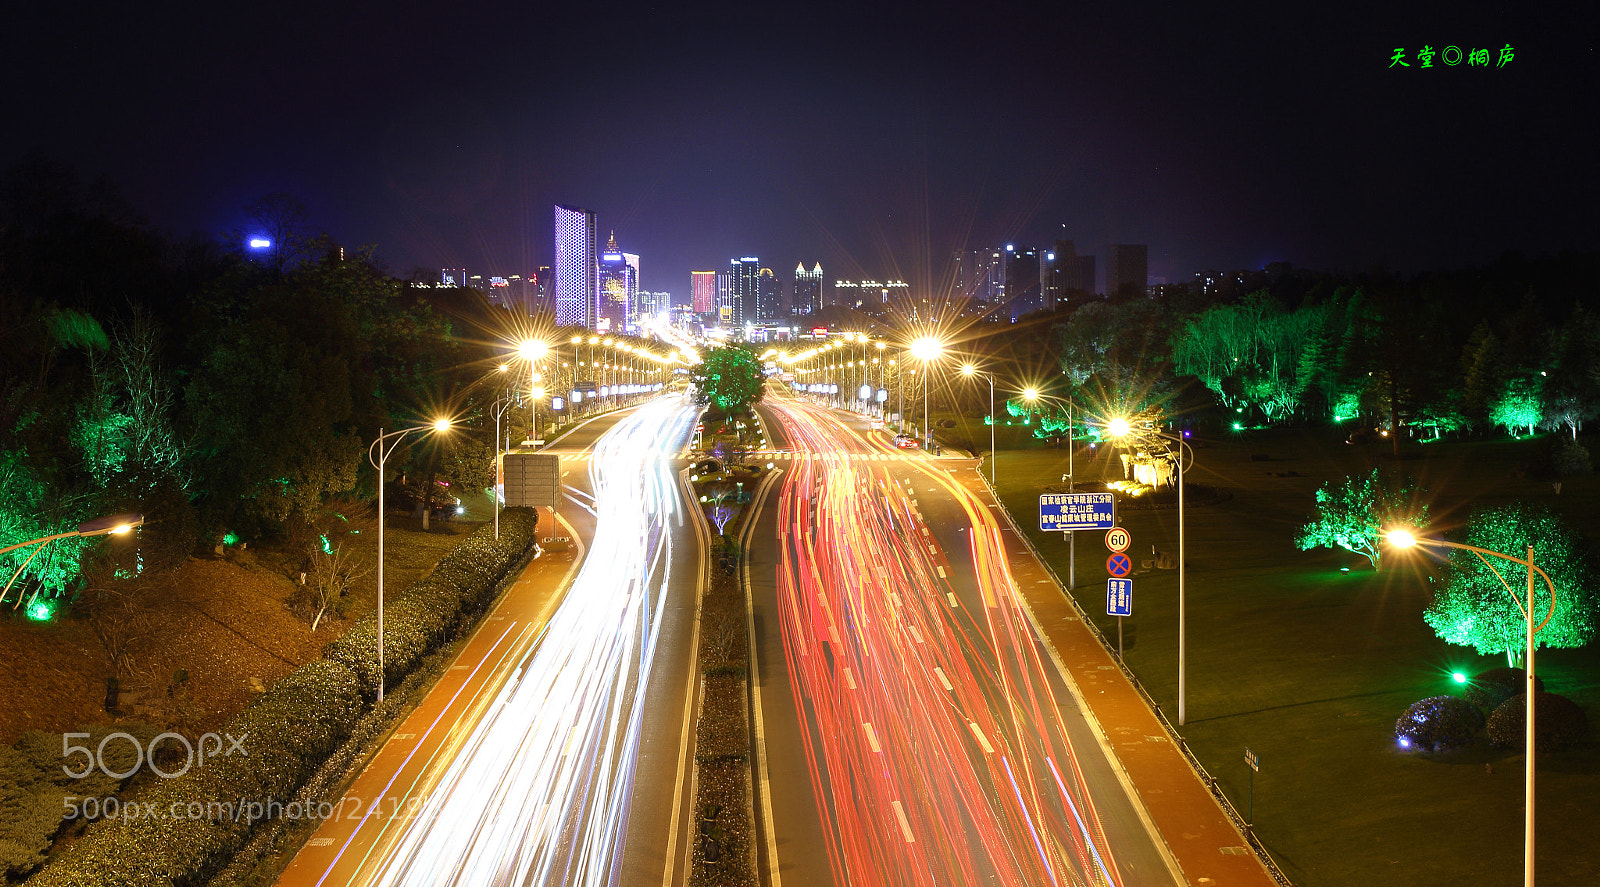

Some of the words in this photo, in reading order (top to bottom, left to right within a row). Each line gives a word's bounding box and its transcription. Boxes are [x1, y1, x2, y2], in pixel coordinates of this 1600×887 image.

[1060, 504, 1094, 514] 凌云山庄
[1111, 534, 1126, 546] 60
